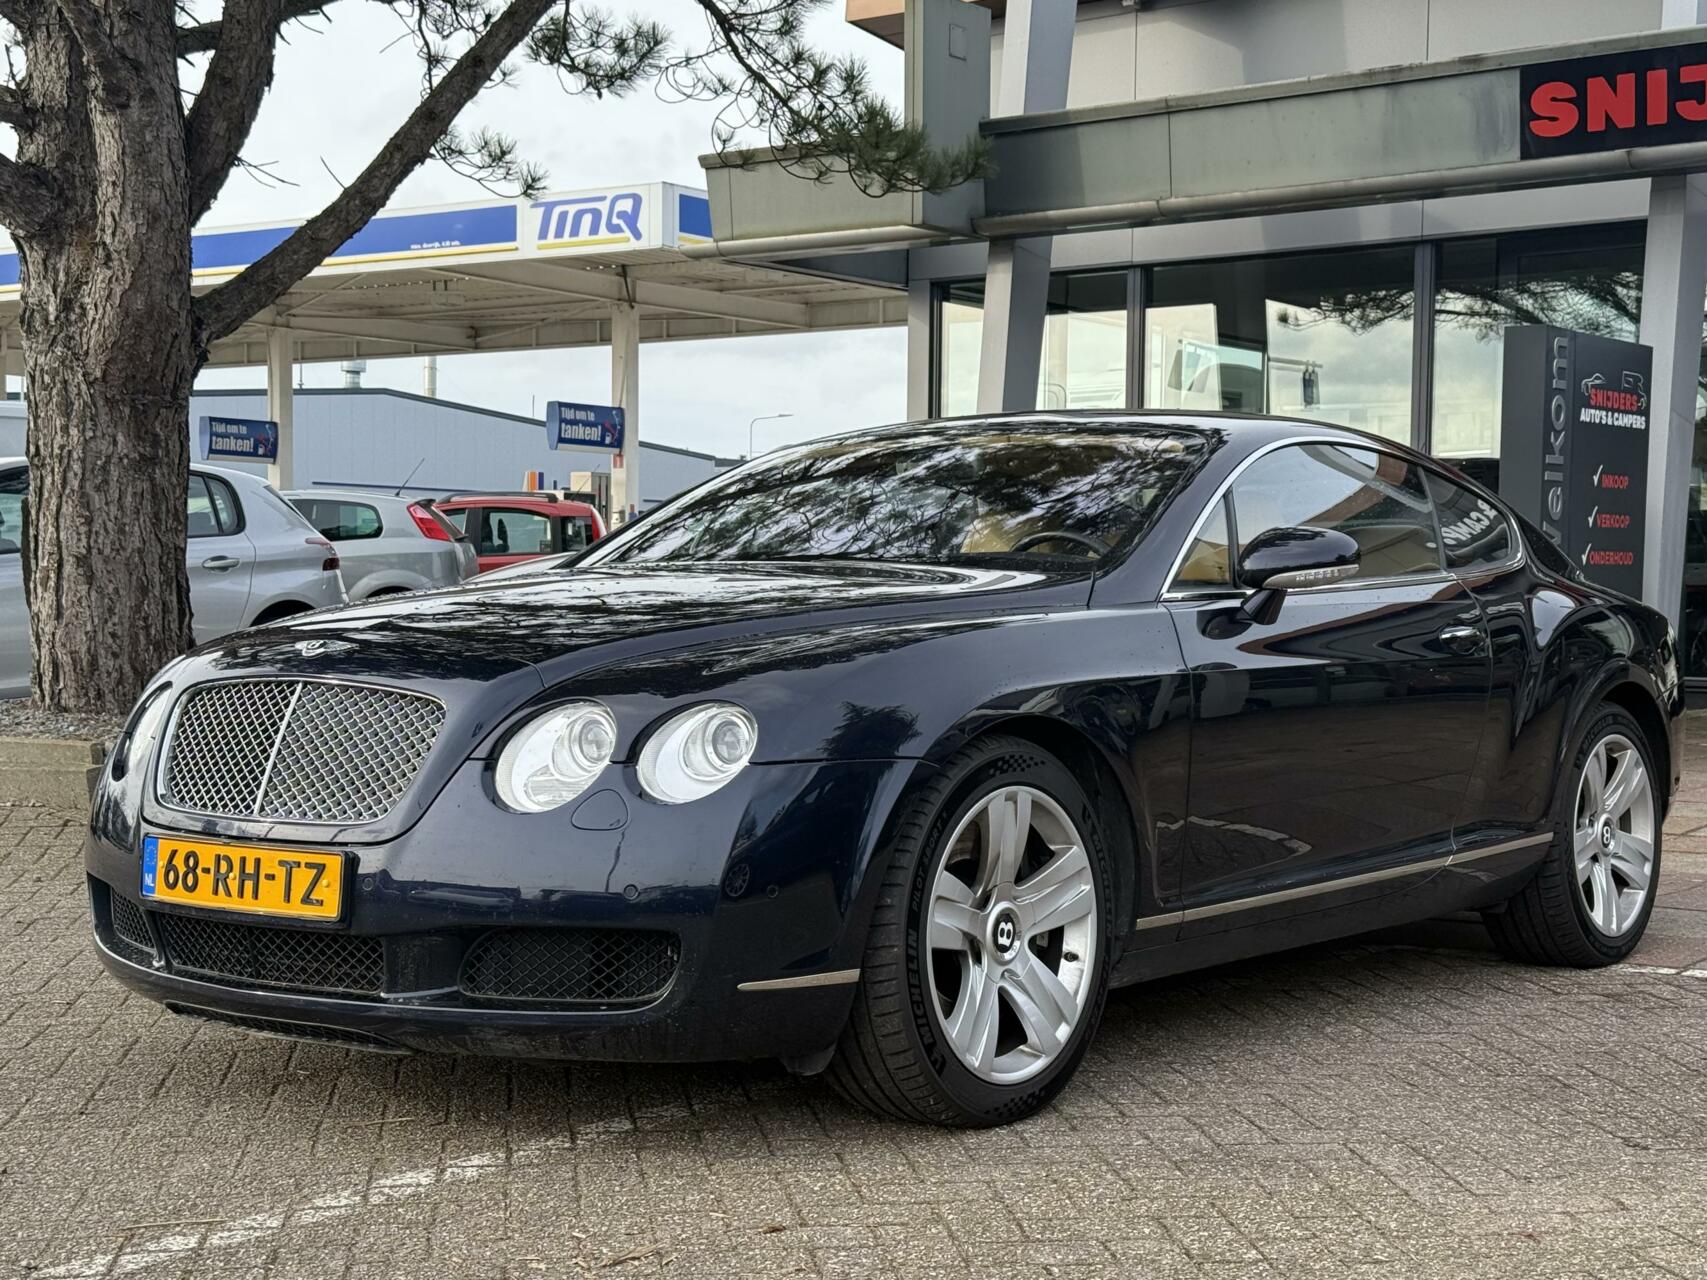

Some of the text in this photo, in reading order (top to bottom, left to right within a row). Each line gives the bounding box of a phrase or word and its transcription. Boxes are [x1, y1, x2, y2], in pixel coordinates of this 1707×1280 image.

[1590, 387, 1638, 412] SNIJDERS
[561, 406, 596, 422] Tijd om te
[1580, 407, 1646, 430] AUTO'S & CAMPERS
[211, 421, 227, 434] Tijd
[561, 422, 602, 442] tanken!
[211, 435, 254, 452] tanken!
[1602, 473, 1629, 489] INKOOP
[1596, 512, 1630, 528] VERKOOP
[1589, 550, 1634, 565] ONDERHOUD
[144, 873, 154, 887] NL
[163, 849, 327, 907] 68-RH-TZ
